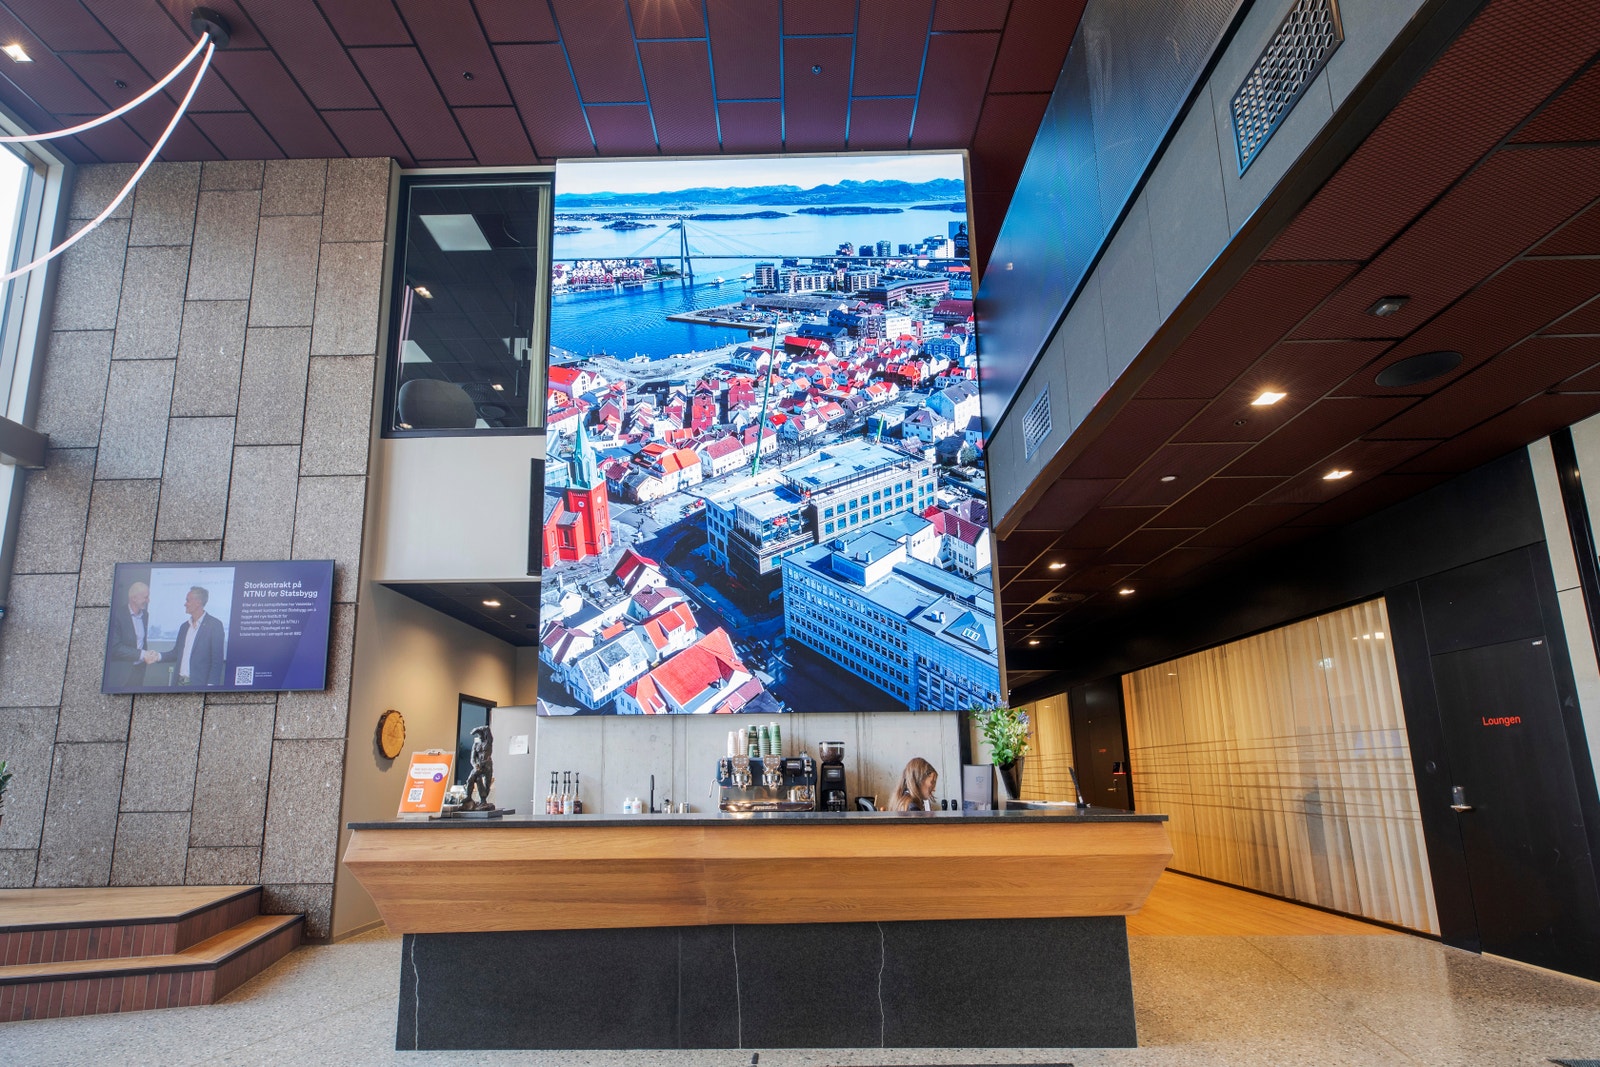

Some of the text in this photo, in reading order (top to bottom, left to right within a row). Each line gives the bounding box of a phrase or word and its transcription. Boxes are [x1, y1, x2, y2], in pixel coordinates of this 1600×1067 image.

[292, 580, 302, 590] på
[243, 590, 267, 598] NTNU
[279, 590, 318, 598] Statsbygg
[1481, 715, 1521, 727] Loungen
